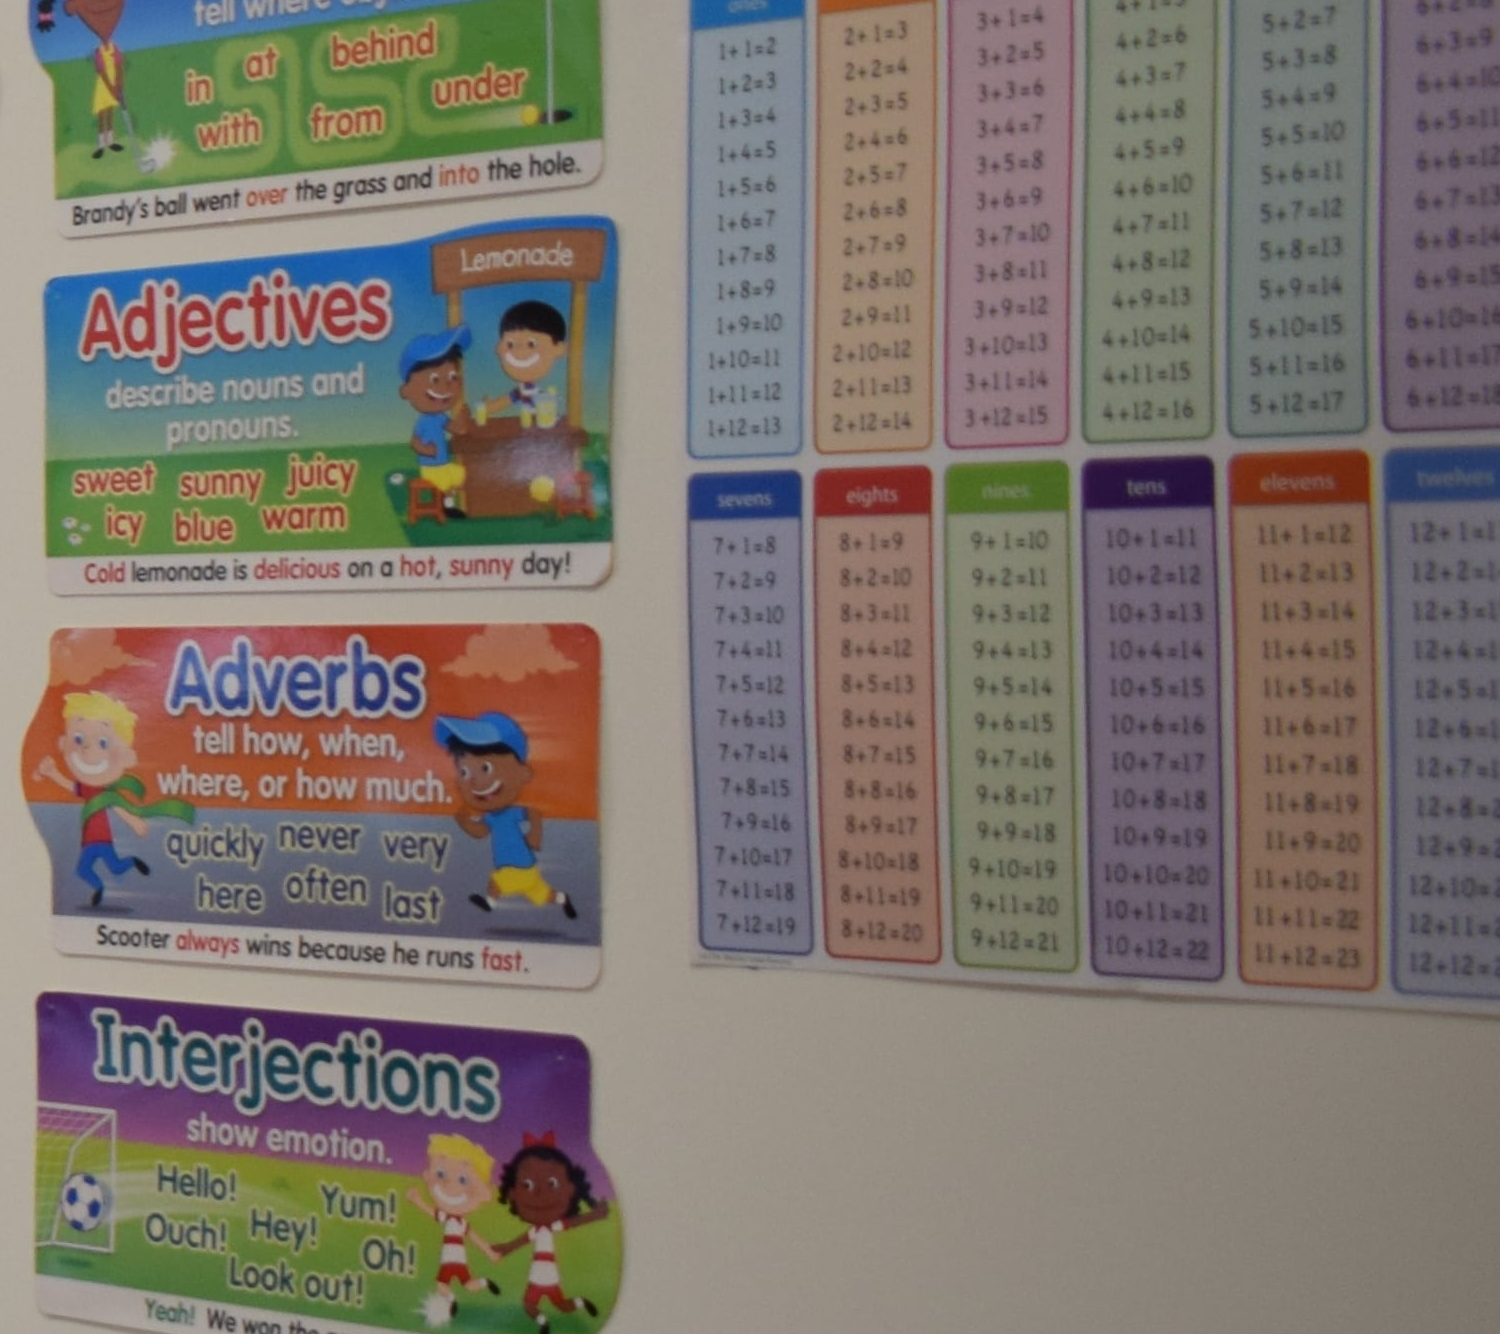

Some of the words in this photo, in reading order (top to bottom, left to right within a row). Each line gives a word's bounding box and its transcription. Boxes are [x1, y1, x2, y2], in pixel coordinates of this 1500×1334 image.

[72, 198, 150, 227] Brandy's
[154, 191, 186, 217] ball
[193, 190, 240, 213] went
[246, 187, 287, 208] over
[294, 177, 328, 201] the
[334, 176, 386, 205] grass
[394, 169, 432, 193] and
[438, 163, 480, 185] into
[488, 158, 522, 182] the
[528, 151, 582, 178] hole.
[460, 242, 574, 273] Lemonade
[80, 269, 394, 369] Adjectives
[106, 375, 215, 409] describe
[222, 375, 303, 404] nouns
[312, 363, 364, 397] and
[166, 416, 299, 449] pronouns.
[716, 488, 773, 510] sevens
[846, 483, 898, 508] eights
[981, 479, 1030, 502] nines
[1126, 476, 1167, 499] tens
[1259, 470, 1335, 493] elevens
[166, 636, 426, 717] Adverbs
[194, 725, 235, 755] tell
[242, 725, 310, 761] how,
[319, 728, 404, 761] when,
[156, 768, 249, 801] where,
[258, 773, 284, 798] or
[296, 769, 358, 801] how
[366, 771, 452, 804] much.
[92, 1009, 500, 1122] Interjections
[186, 1115, 258, 1149] show
[267, 1127, 394, 1164] emotion.
